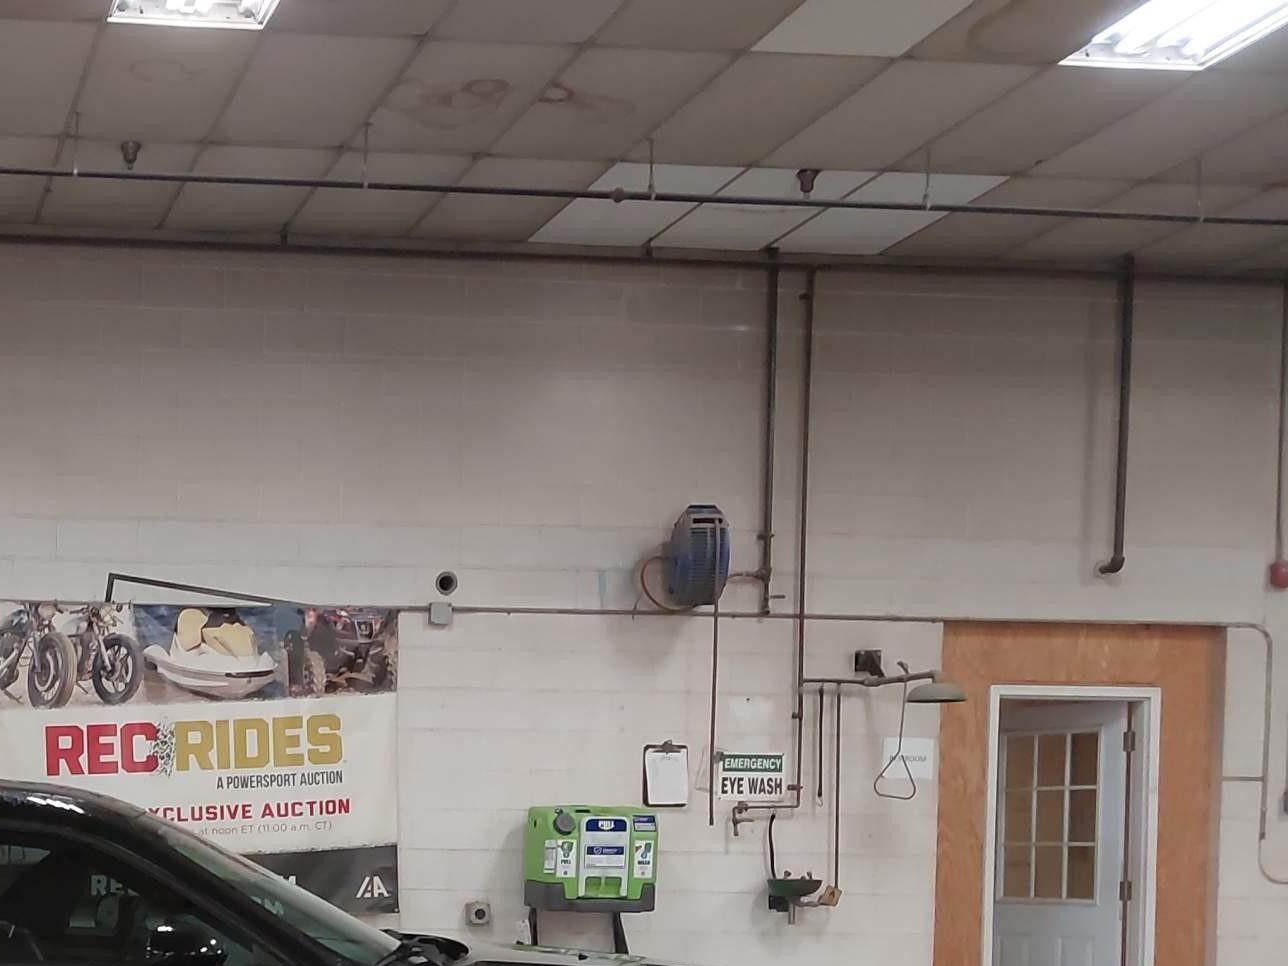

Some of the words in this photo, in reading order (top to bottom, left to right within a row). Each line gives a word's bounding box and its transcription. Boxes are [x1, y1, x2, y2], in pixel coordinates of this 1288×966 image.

[45, 722, 159, 776] REC
[174, 714, 343, 772] RIDES
[724, 758, 781, 769] EMERGENCY
[216, 776, 224, 789] A
[227, 773, 297, 789] POWERSPORT
[300, 770, 343, 786] AUCTION
[721, 777, 744, 794] EYE
[748, 777, 782, 794] WASH
[145, 804, 252, 822] XCLUSIVE
[261, 799, 350, 818] AUCTION
[241, 824, 253, 834] ET
